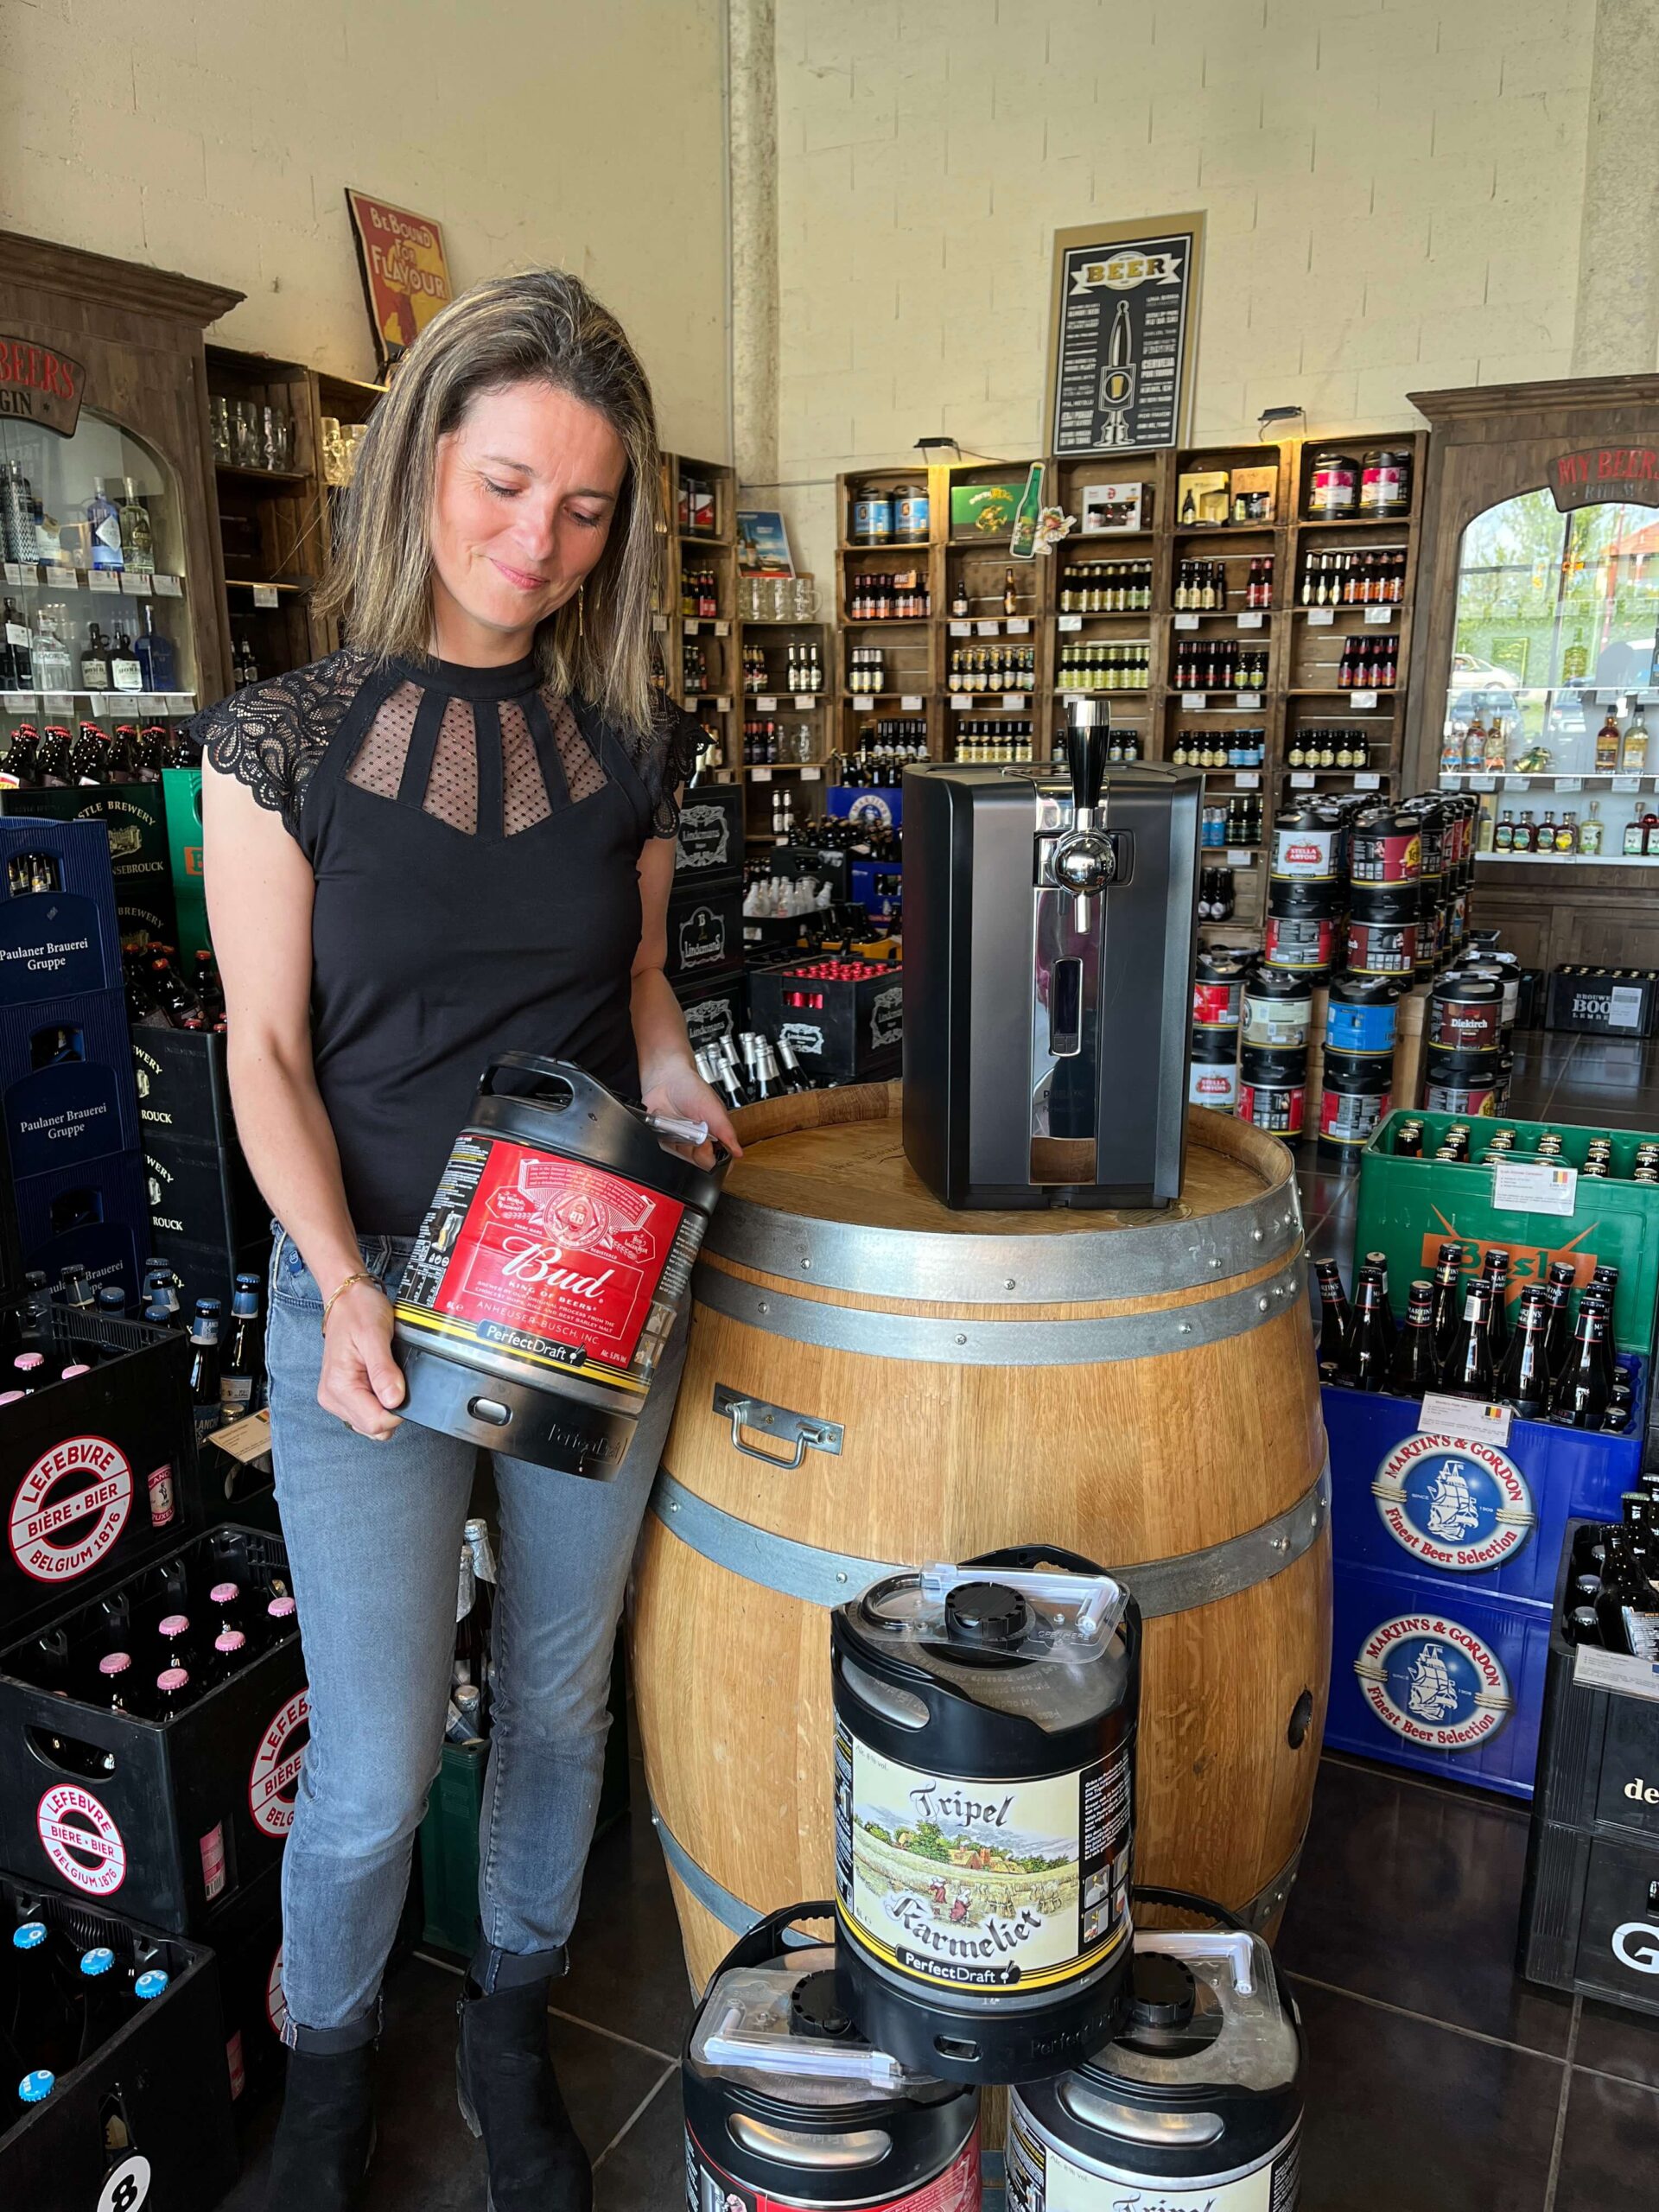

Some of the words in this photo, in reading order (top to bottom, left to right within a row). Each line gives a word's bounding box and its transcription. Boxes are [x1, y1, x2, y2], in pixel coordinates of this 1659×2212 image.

[388, 213, 432, 248] BOUND
[395, 238, 416, 265] FOR
[371, 245, 446, 299] FLAVOUR
[1086, 258, 1166, 283] BEER
[0, 389, 33, 415] GIN
[1557, 453, 1592, 486] MY
[1597, 448, 1659, 480] BEER
[77, 802, 103, 819] STLE
[107, 800, 156, 826] BREWERY
[112, 861, 164, 875] SEBROUCK
[118, 907, 164, 929] BREWERY
[0, 944, 44, 961] Paulaner
[47, 938, 89, 954] Brauerei
[27, 957, 67, 971] Gruppe
[1572, 999, 1611, 1014] BOO
[1576, 993, 1611, 1001] BROUWE
[1451, 1018, 1488, 1029] Diekirch
[20, 1114, 65, 1133] Paulaner
[67, 1103, 107, 1122] Brauerei
[48, 1123, 85, 1140] Gruppe
[144, 1154, 175, 1184] WERY
[85, 1260, 124, 1282] Brauerei
[501, 1236, 616, 1300] Bud
[477, 1281, 503, 1293] BREWED
[527, 1295, 557, 1309] ORIGINAL
[559, 1306, 587, 1319] PROCESS
[588, 1314, 604, 1324] FROM
[508, 1280, 536, 1296] KING
[539, 1287, 555, 1299] OF
[475, 1287, 505, 1300] CHOICEST
[526, 1301, 542, 1312] RICE
[543, 1306, 557, 1315] AND
[558, 1312, 574, 1322] BEST
[575, 1316, 598, 1329] BARLEY
[598, 1324, 613, 1333] MALT
[486, 1325, 568, 1361] PerfectDraft
[581, 1332, 601, 1345] INC.
[22, 1444, 115, 1504] LEFEBVRE
[1384, 1434, 1451, 1479] MARTIN'S
[1454, 1437, 1469, 1450] &
[1470, 1442, 1523, 1502] GORDON
[28, 1504, 73, 1538] BIÈRE
[84, 1482, 118, 1510] BIER
[29, 1547, 92, 1573] BELGIUM
[93, 1512, 120, 1550] 1876
[1385, 1507, 1421, 1548] Finest
[1420, 1541, 1453, 1563] Beer
[1457, 1529, 1518, 1565] Selection
[1366, 1618, 1431, 1659] MARTIN'S
[1433, 1620, 1447, 1635] &
[1448, 1627, 1501, 1688] GORDON
[260, 1696, 311, 1762] LEFEB
[1367, 1685, 1402, 1726] Finest
[1401, 1719, 1433, 1742] Beer
[1437, 1713, 1496, 1745] Selection
[264, 1756, 302, 1797] BIÈRE
[47, 1791, 112, 1833] LEFEBVRE
[266, 1807, 295, 1827] BELG
[910, 1780, 1015, 1827] Tripel
[50, 1825, 83, 1845] BIÈRE
[91, 1838, 115, 1858] BIER
[52, 1848, 99, 1888] BELGIUM
[98, 1868, 118, 1887] 1876
[884, 1890, 1042, 1959] Karmeliet
[905, 1951, 996, 1984] PerfectDraft
[111, 2173, 138, 2212] 8
